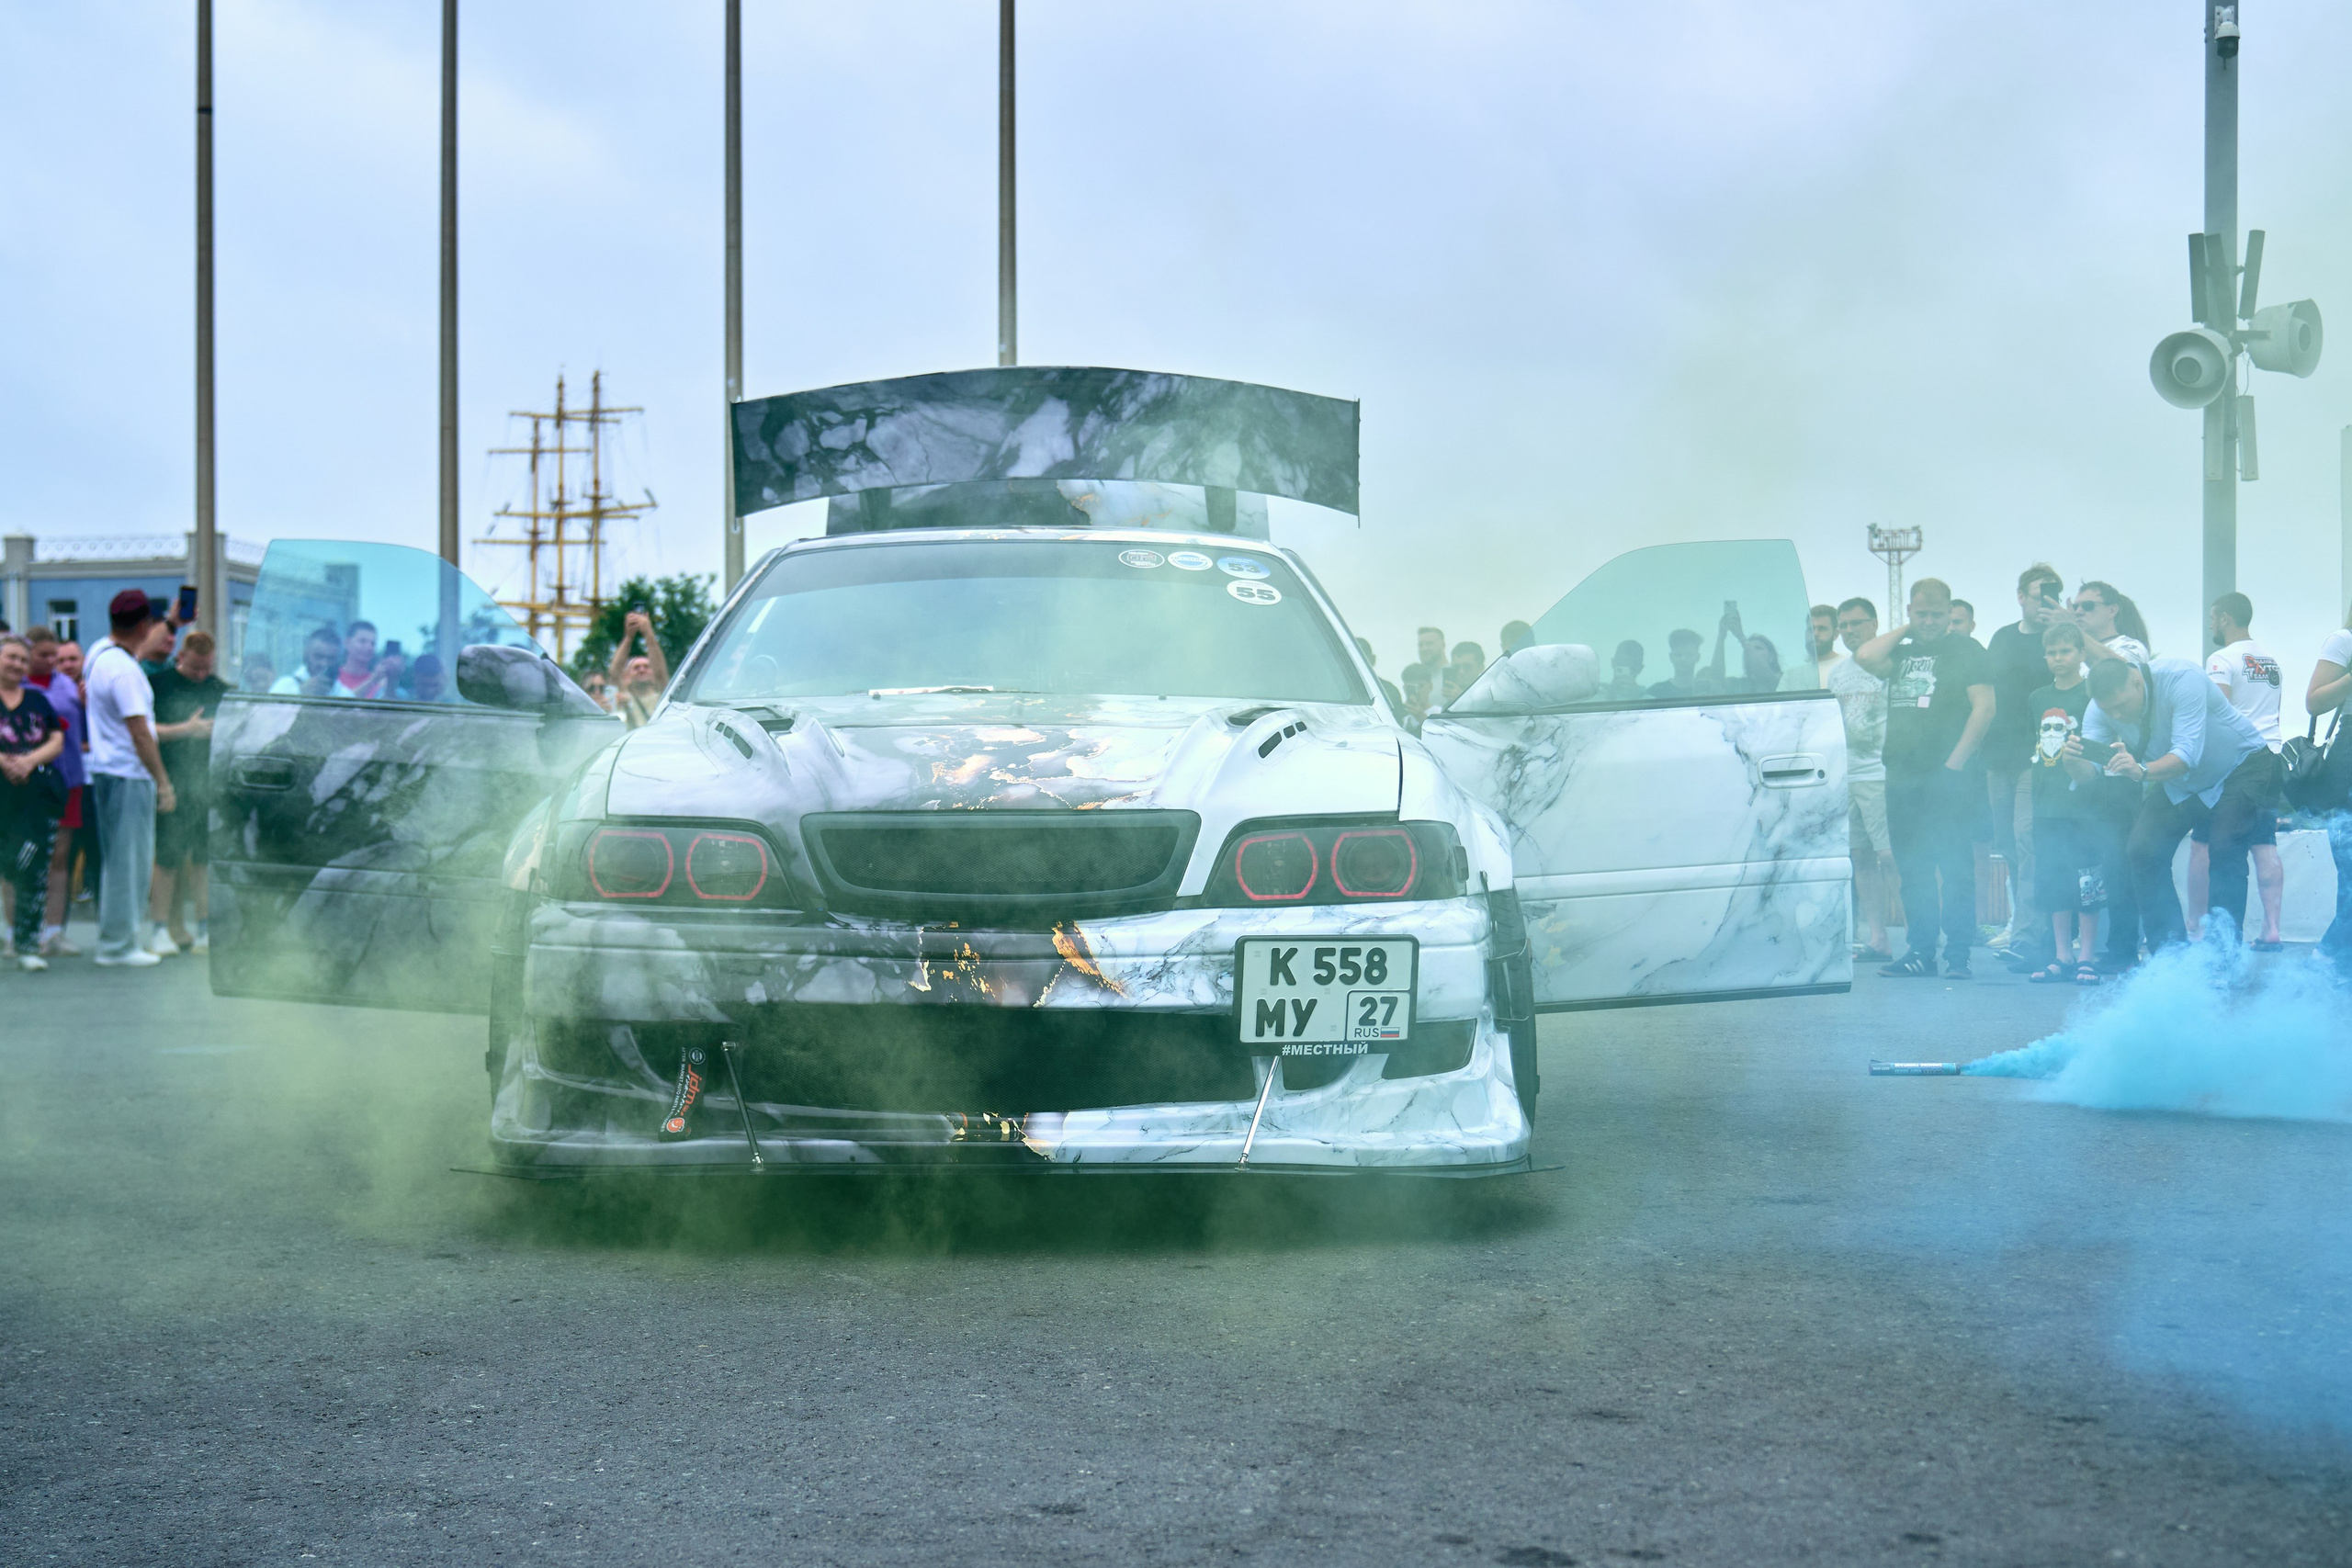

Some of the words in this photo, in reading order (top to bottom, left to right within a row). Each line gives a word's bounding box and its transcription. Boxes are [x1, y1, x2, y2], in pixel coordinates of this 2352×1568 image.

[1227, 562, 1261, 574] 53
[1236, 586, 1276, 601] 55
[1270, 947, 1298, 986] К
[1313, 947, 1388, 986] 558
[1255, 998, 1317, 1037] МУ
[1358, 997, 1398, 1026] 27
[1353, 1028, 1379, 1038] RUS
[1282, 1042, 1368, 1055] #МЕСТНЫЙ
